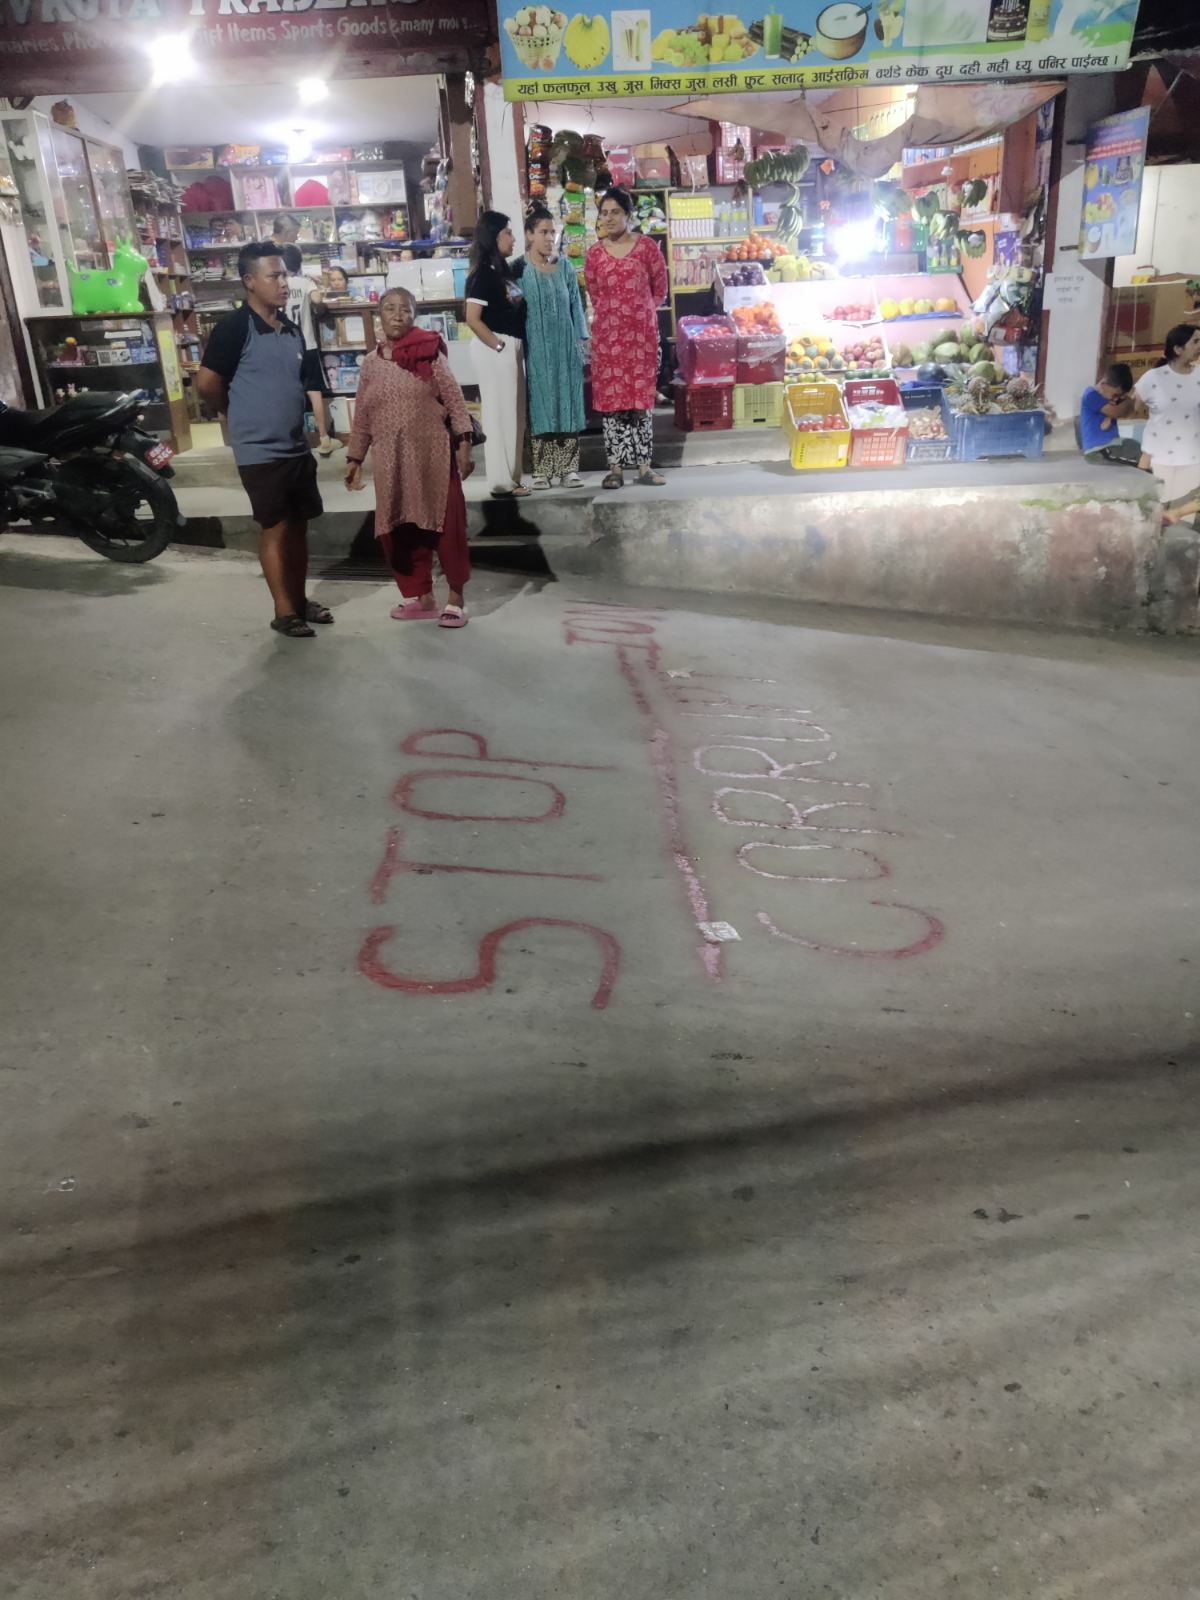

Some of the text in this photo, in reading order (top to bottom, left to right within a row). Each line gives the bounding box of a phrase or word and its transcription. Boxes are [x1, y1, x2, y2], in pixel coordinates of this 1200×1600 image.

[227, 22, 276, 42] Items
[280, 19, 335, 42] Sports
[337, 16, 387, 36] Goods
[401, 18, 434, 35] many
[357, 728, 618, 1010] STOP
